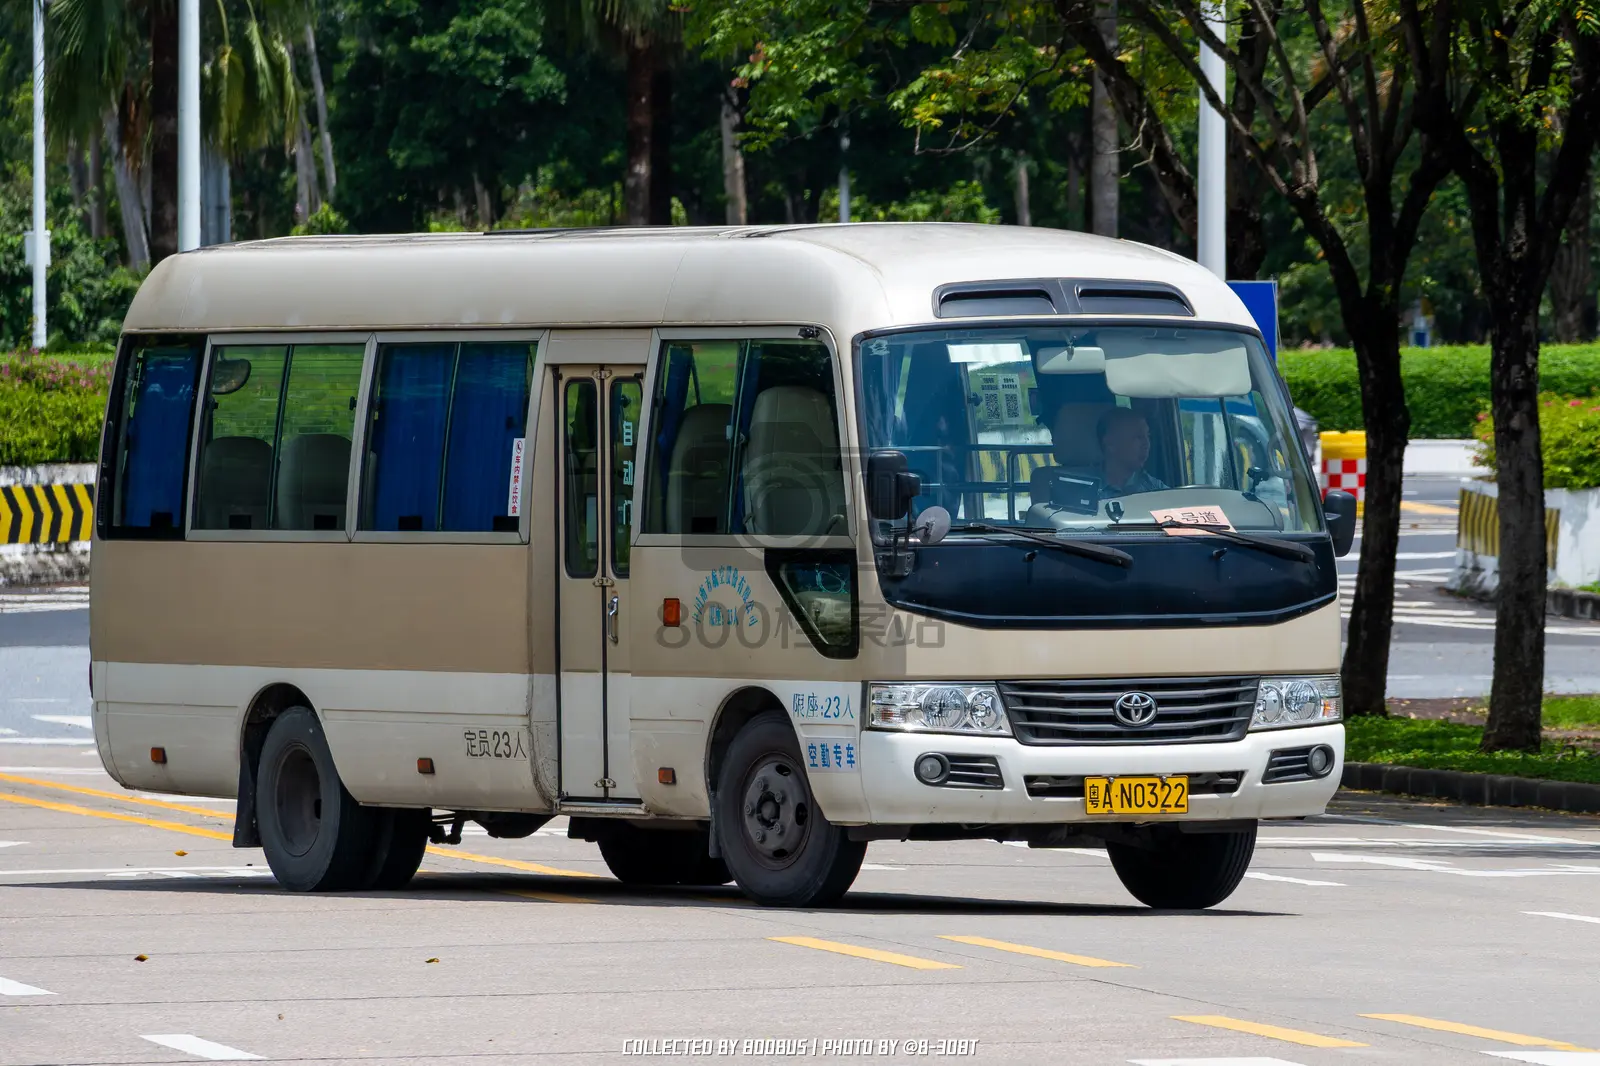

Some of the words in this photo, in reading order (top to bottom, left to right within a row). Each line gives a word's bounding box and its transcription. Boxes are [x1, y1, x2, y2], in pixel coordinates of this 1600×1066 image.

[511, 455, 521, 514] 车内禁止饮食
[464, 730, 527, 759] 定员23人
[808, 742, 856, 769] 空勤专车
